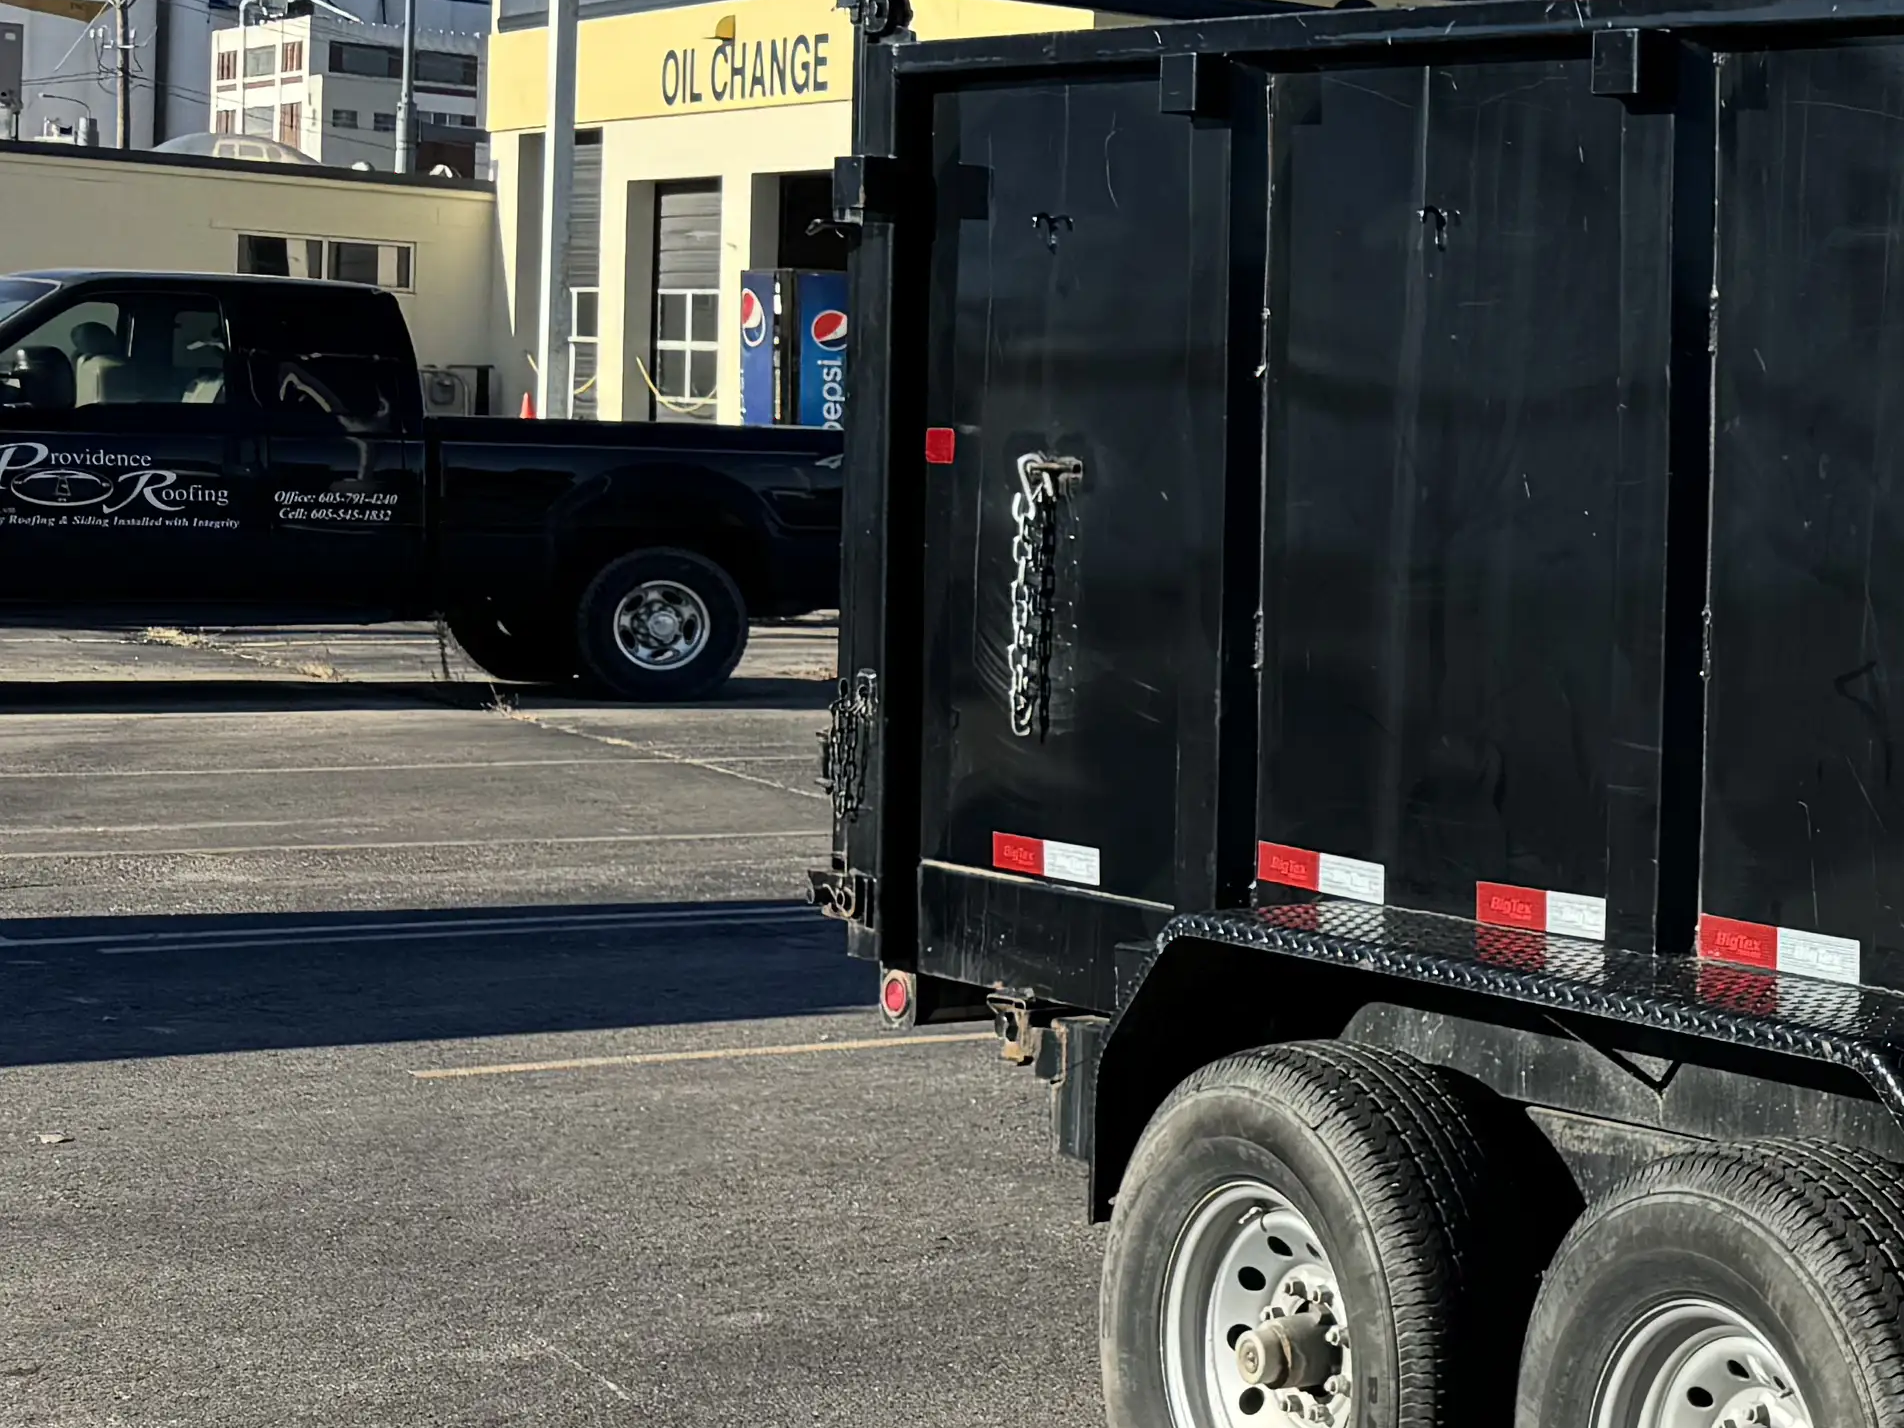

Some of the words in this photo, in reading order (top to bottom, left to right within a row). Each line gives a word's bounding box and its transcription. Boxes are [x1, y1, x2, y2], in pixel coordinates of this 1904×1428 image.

[662, 48, 703, 107] OIL
[711, 33, 829, 102] CHANGE
[0, 442, 151, 489] Providence
[102, 470, 230, 515] Roofing
[274, 490, 316, 505] Office:
[8, 515, 56, 527] Roofing
[59, 515, 68, 525] &
[71, 515, 110, 527] Siding
[113, 516, 163, 526] Installed
[164, 517, 189, 527] with
[193, 517, 240, 529] Integrity
[279, 507, 308, 520] Cell:
